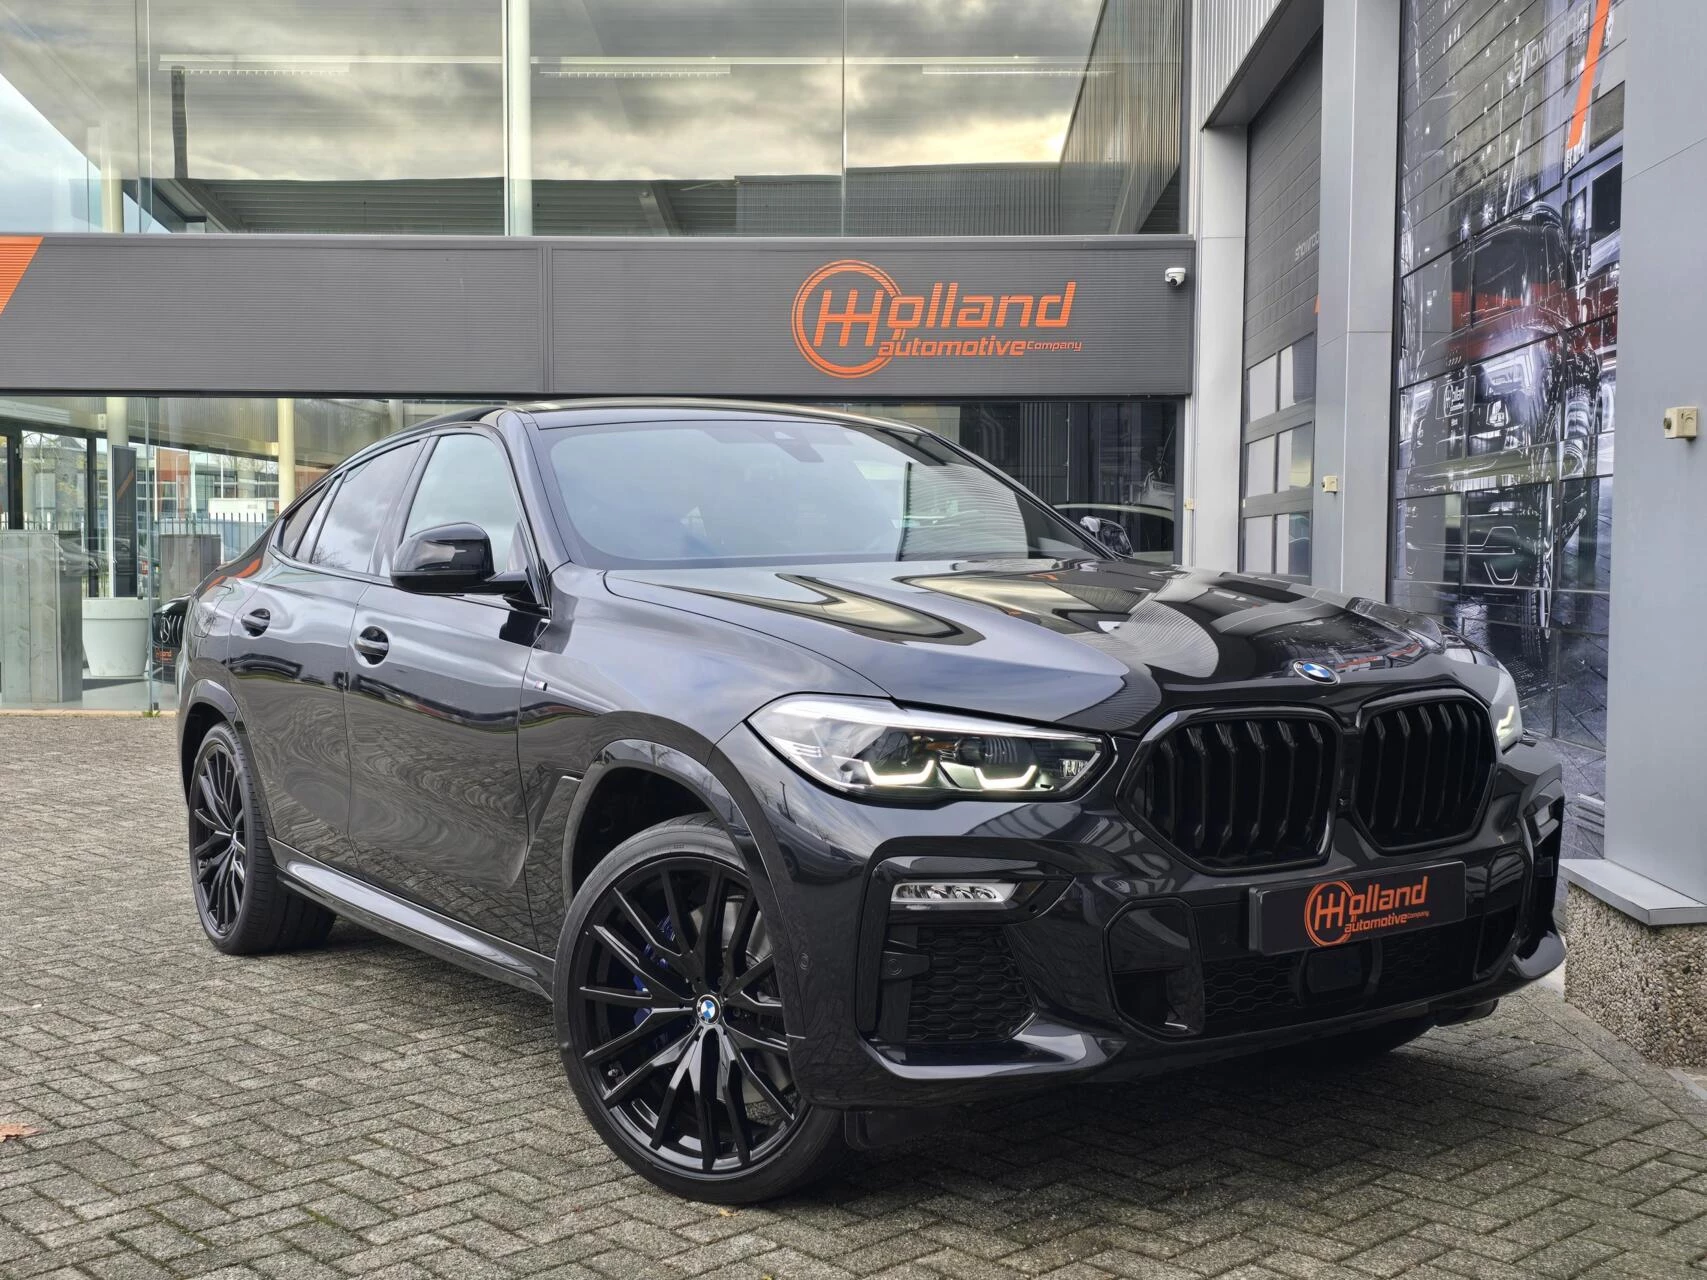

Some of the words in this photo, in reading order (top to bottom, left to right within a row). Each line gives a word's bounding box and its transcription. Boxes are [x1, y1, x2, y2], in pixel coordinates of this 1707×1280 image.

[811, 280, 1077, 347] Holland
[879, 336, 1025, 357] automotive
[1314, 876, 1428, 930] Holland
[1344, 913, 1408, 933] automotive
